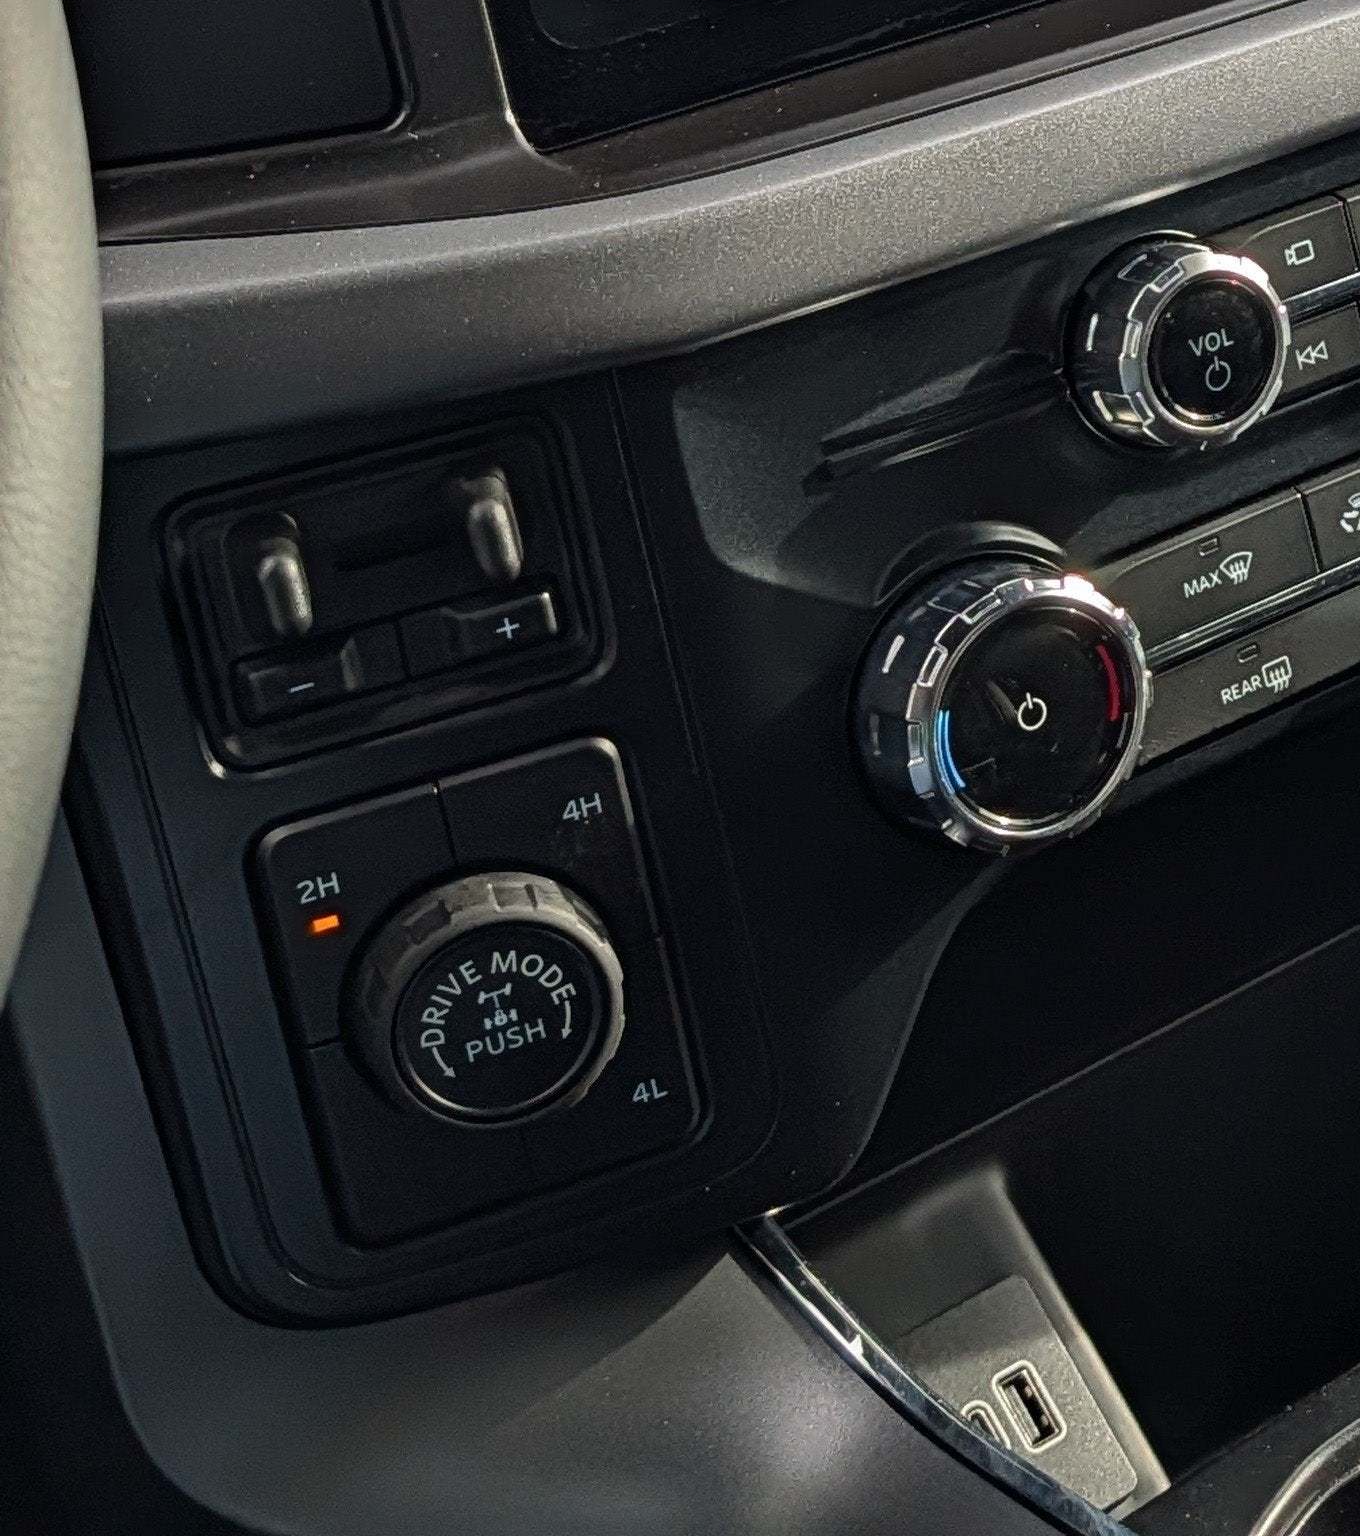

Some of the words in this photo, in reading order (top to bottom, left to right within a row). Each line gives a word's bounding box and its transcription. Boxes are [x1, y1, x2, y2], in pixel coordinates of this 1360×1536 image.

[1188, 329, 1234, 357] VOL
[1184, 572, 1222, 597] MAX
[1221, 675, 1262, 704] REAR
[562, 793, 603, 822] 4H
[297, 873, 339, 903] 2H
[420, 959, 483, 1050] DRIVE
[490, 950, 577, 1005] MODE
[466, 1019, 547, 1063] PUSH
[633, 1079, 668, 1102] 4L
